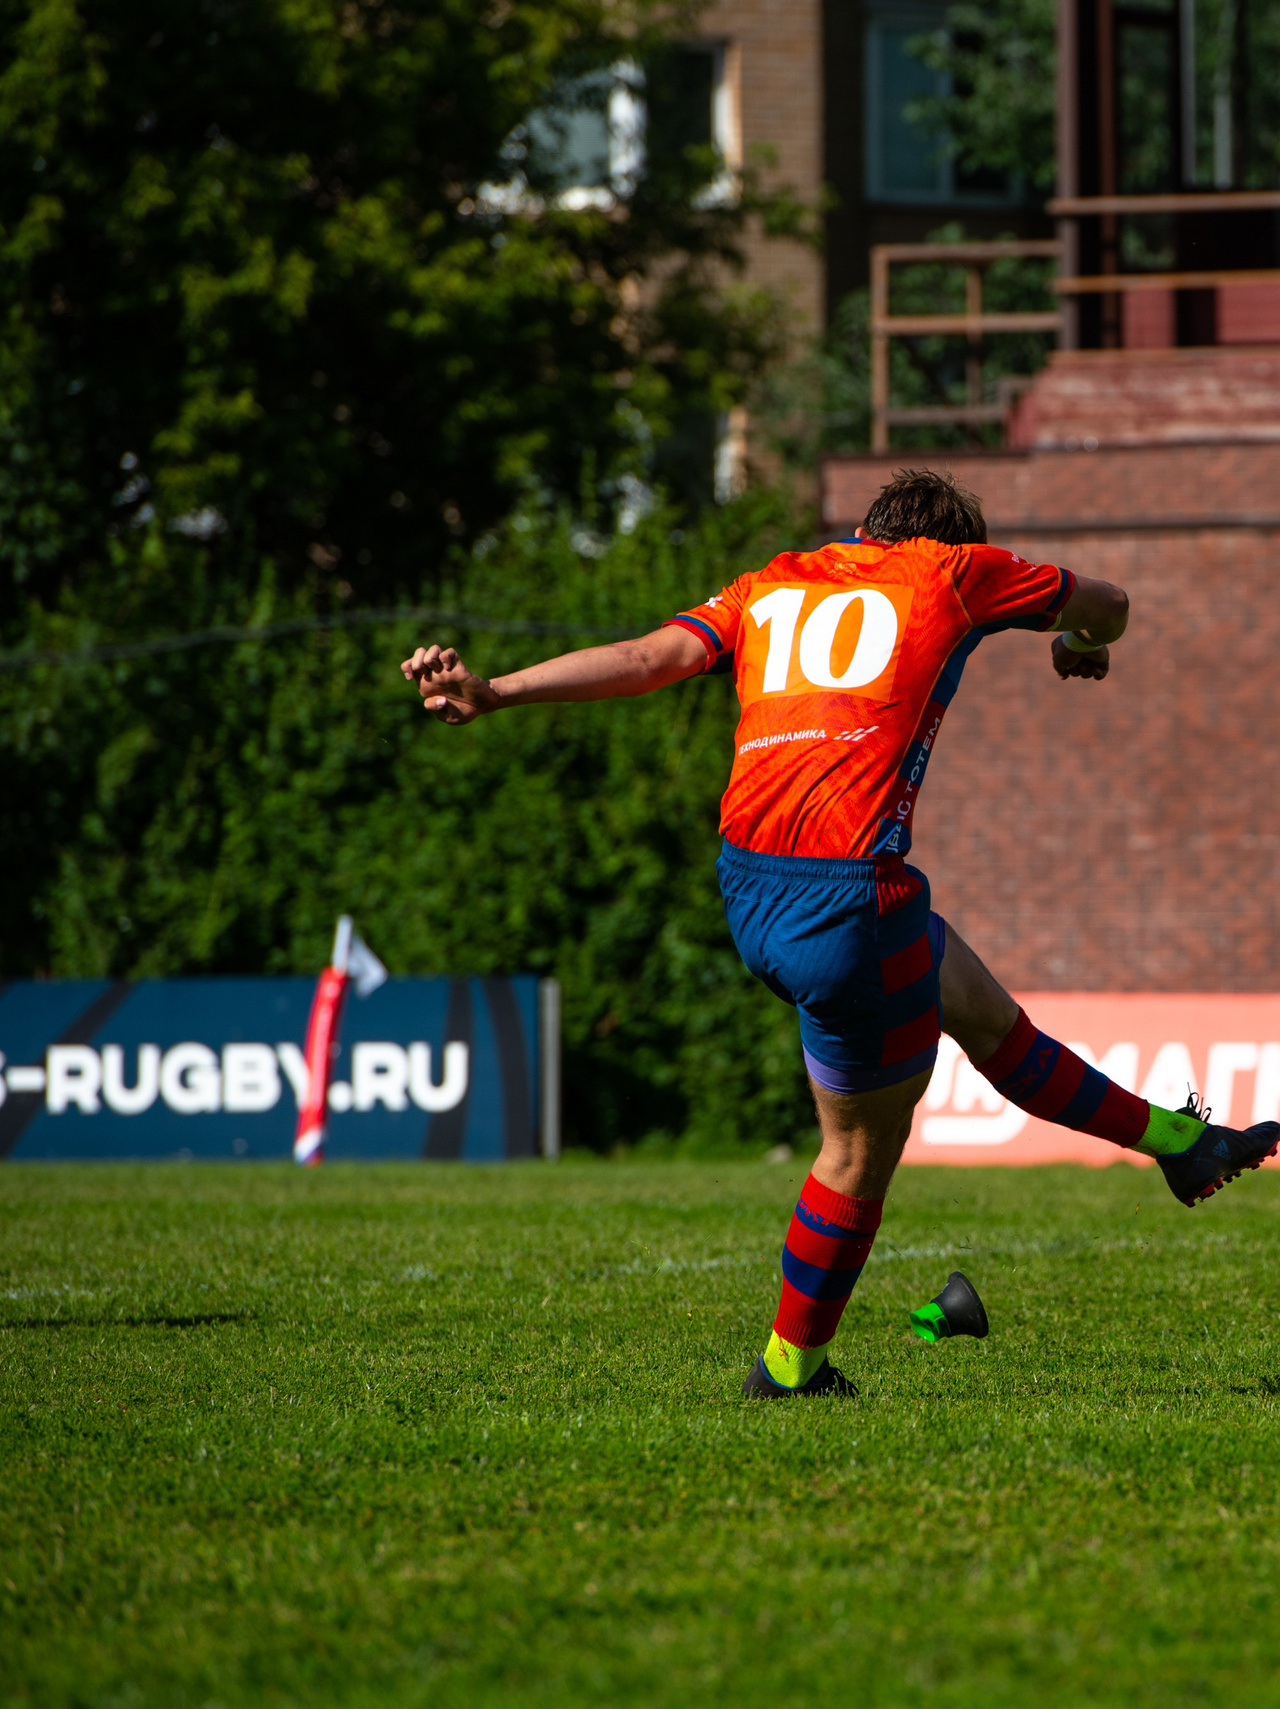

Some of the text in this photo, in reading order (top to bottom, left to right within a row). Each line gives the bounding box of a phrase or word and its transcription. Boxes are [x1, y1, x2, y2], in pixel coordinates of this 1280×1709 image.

[749, 588, 898, 693] 10
[904, 717, 941, 793] TOTEM
[0, 1042, 468, 1115] -RUGBY.RU
